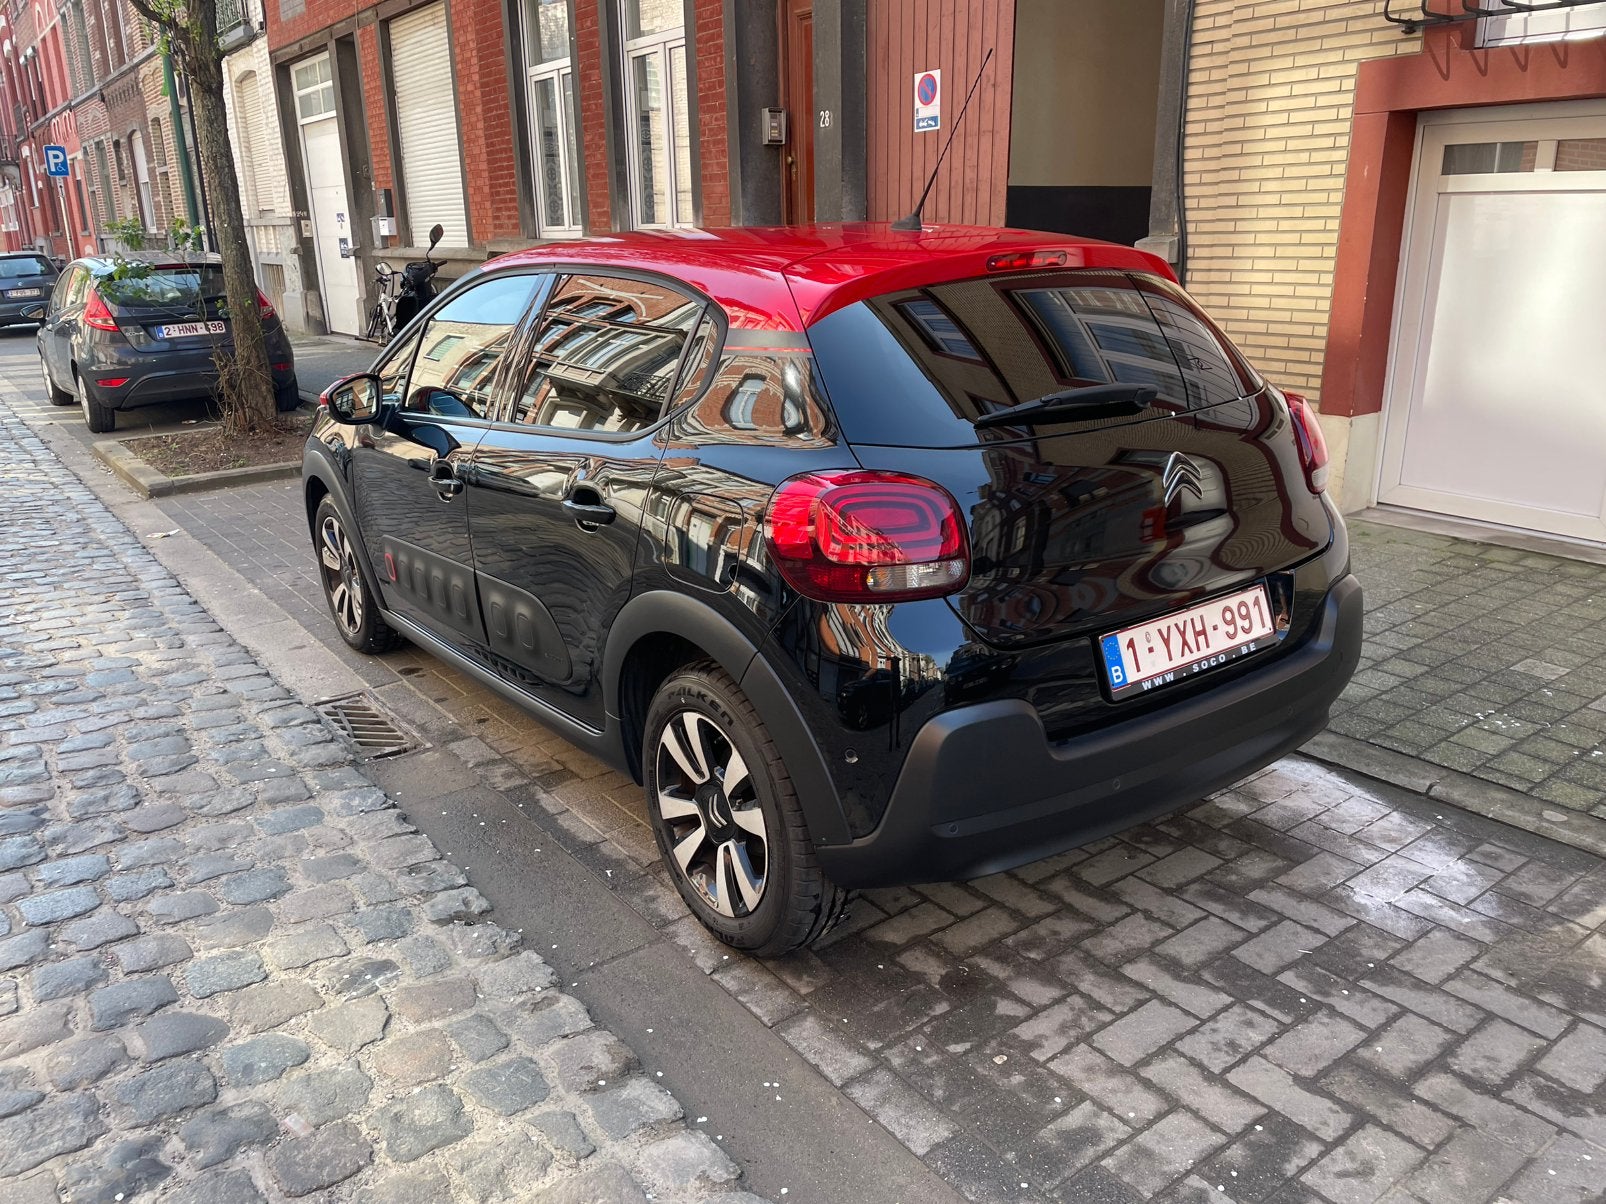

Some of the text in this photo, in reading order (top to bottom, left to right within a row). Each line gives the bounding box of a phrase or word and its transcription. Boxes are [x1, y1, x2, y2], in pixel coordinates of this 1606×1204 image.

[819, 110, 831, 128] 28
[47, 150, 65, 172] P
[1111, 595, 1266, 684] B 1-YXH-991
